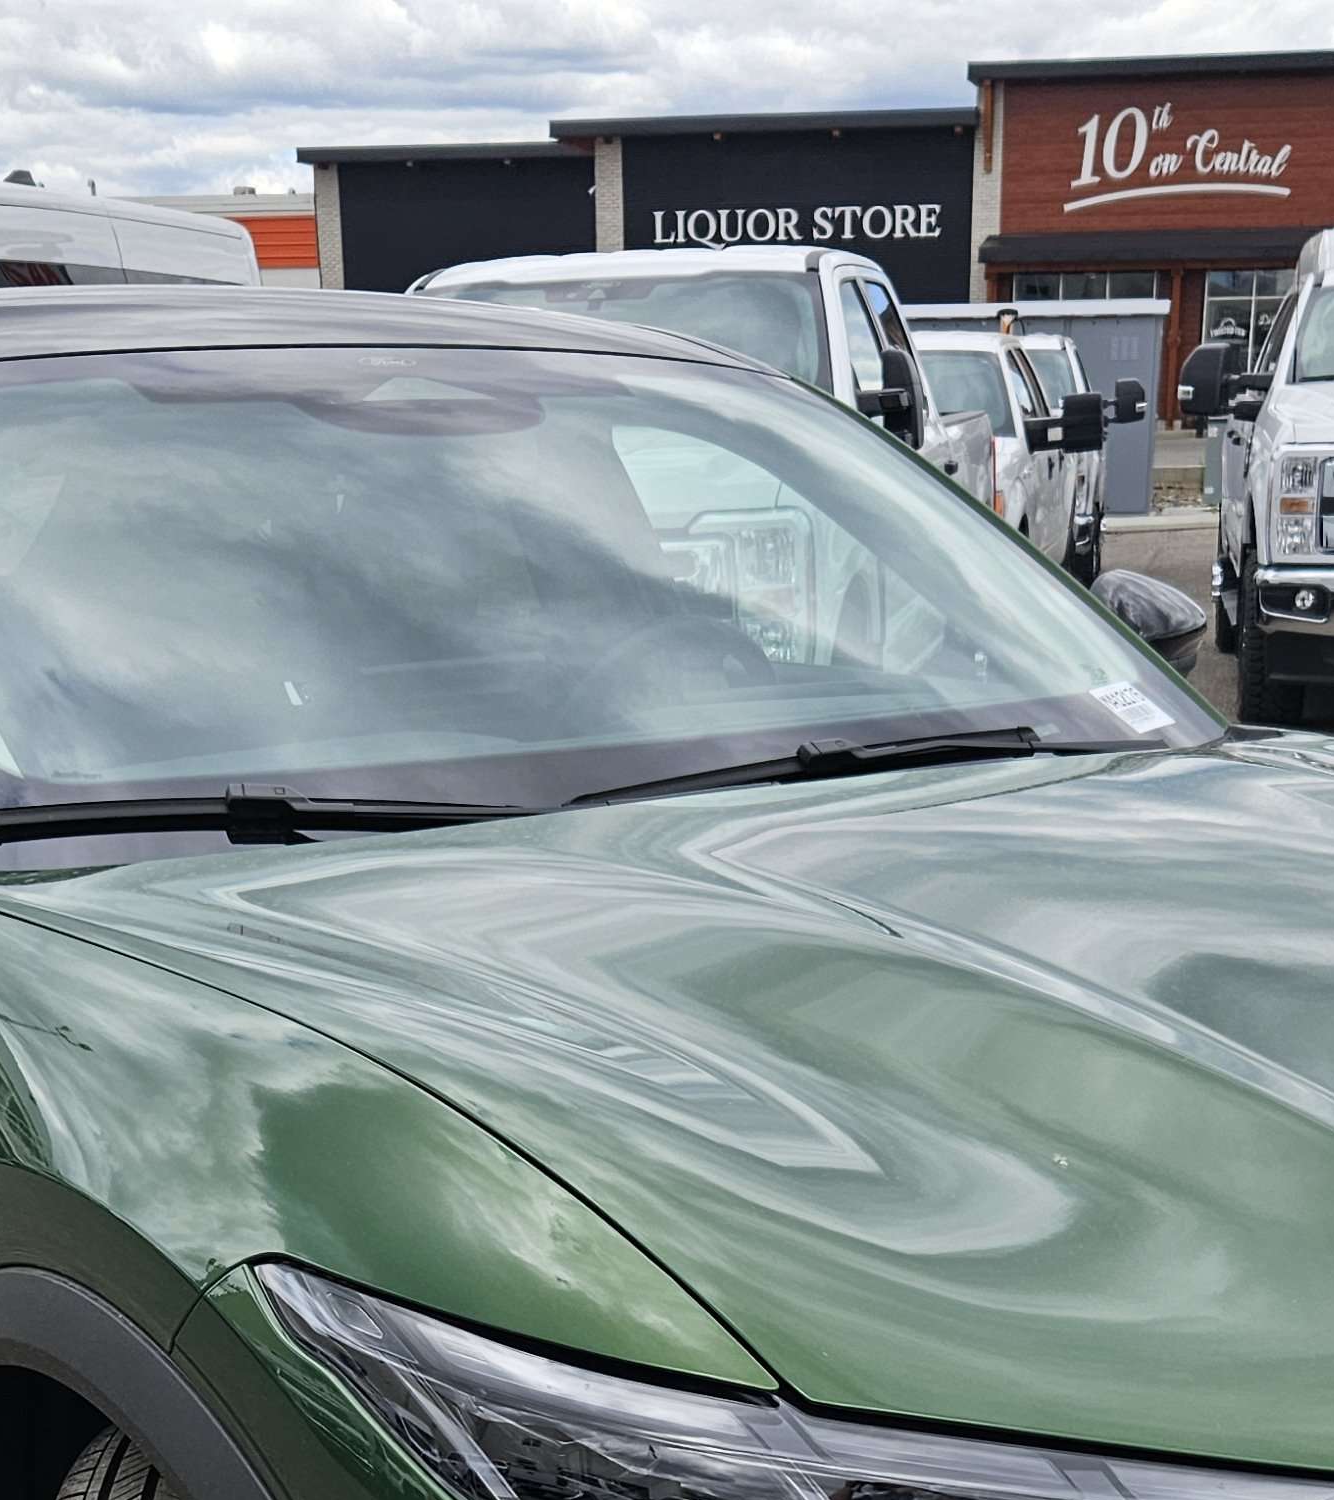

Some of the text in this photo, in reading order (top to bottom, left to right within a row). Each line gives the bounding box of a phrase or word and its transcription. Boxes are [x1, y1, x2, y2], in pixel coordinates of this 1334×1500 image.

[1149, 152, 1183, 179] on
[1186, 128, 1292, 178] Central
[652, 204, 942, 251] LIQUOR STORE
